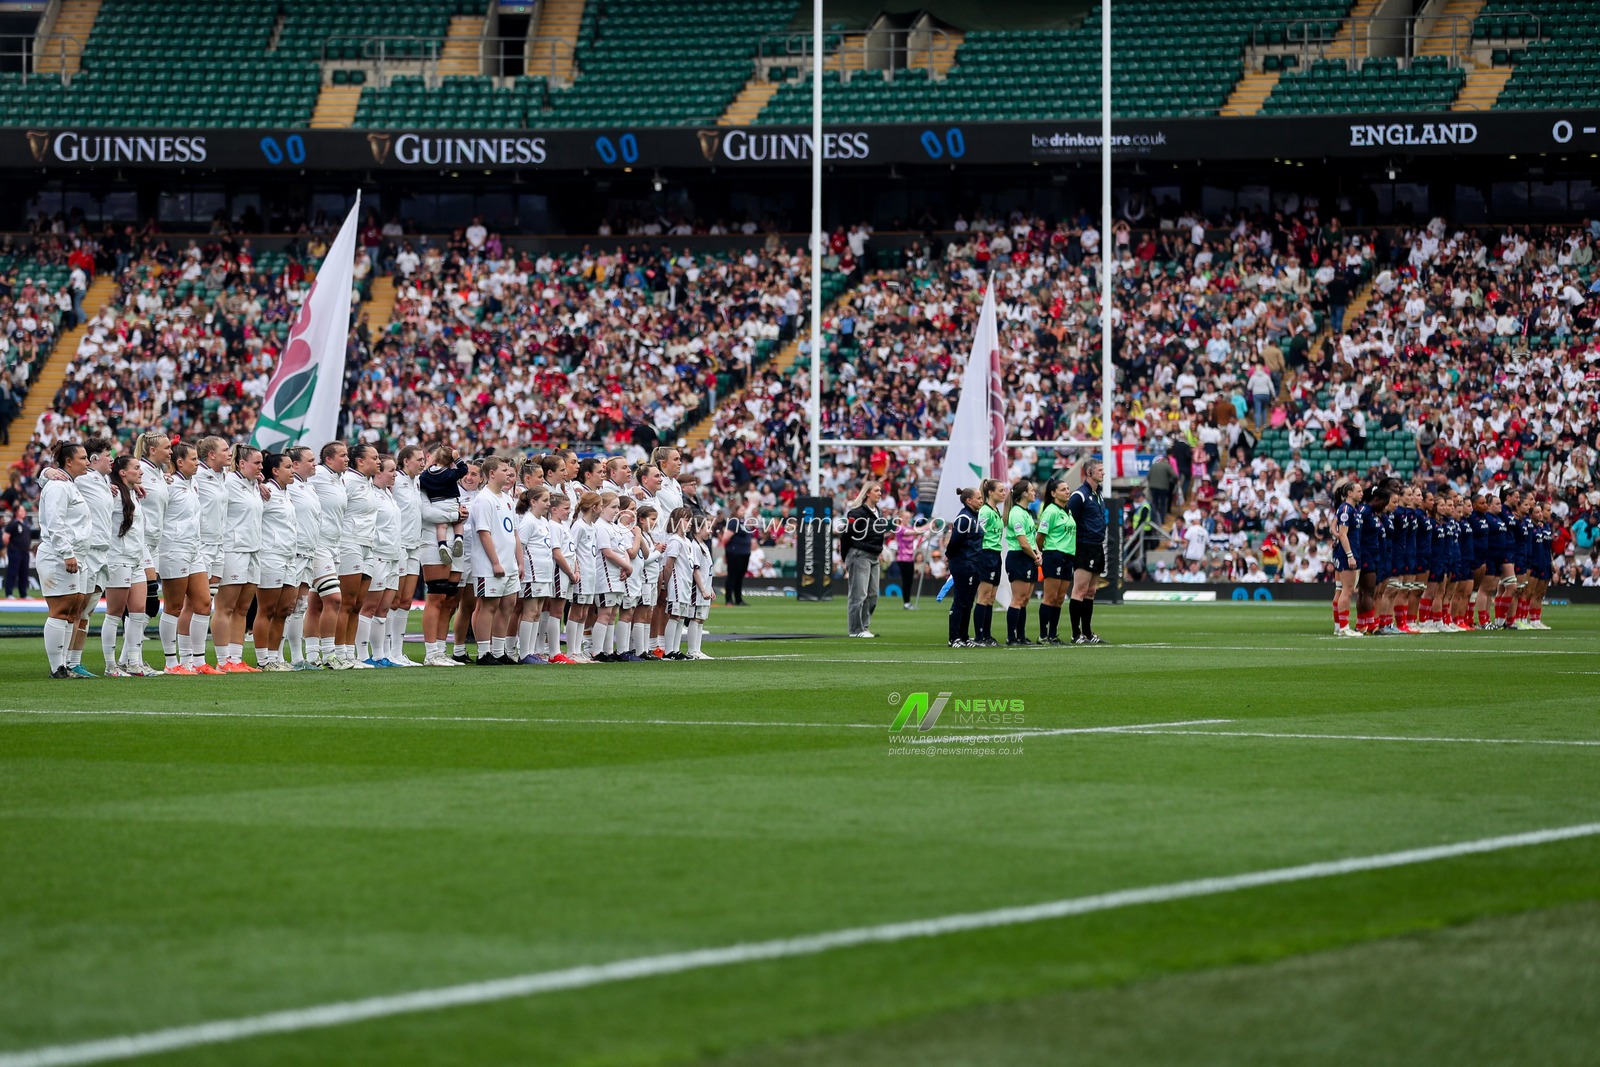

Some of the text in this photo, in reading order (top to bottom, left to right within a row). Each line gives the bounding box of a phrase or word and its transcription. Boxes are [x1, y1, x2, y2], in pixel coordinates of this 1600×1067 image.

[53, 131, 207, 162] GUINNESS
[394, 133, 547, 164] GUINNESS
[722, 130, 870, 161] GUINNESS
[1350, 122, 1478, 147] ENGLAND
